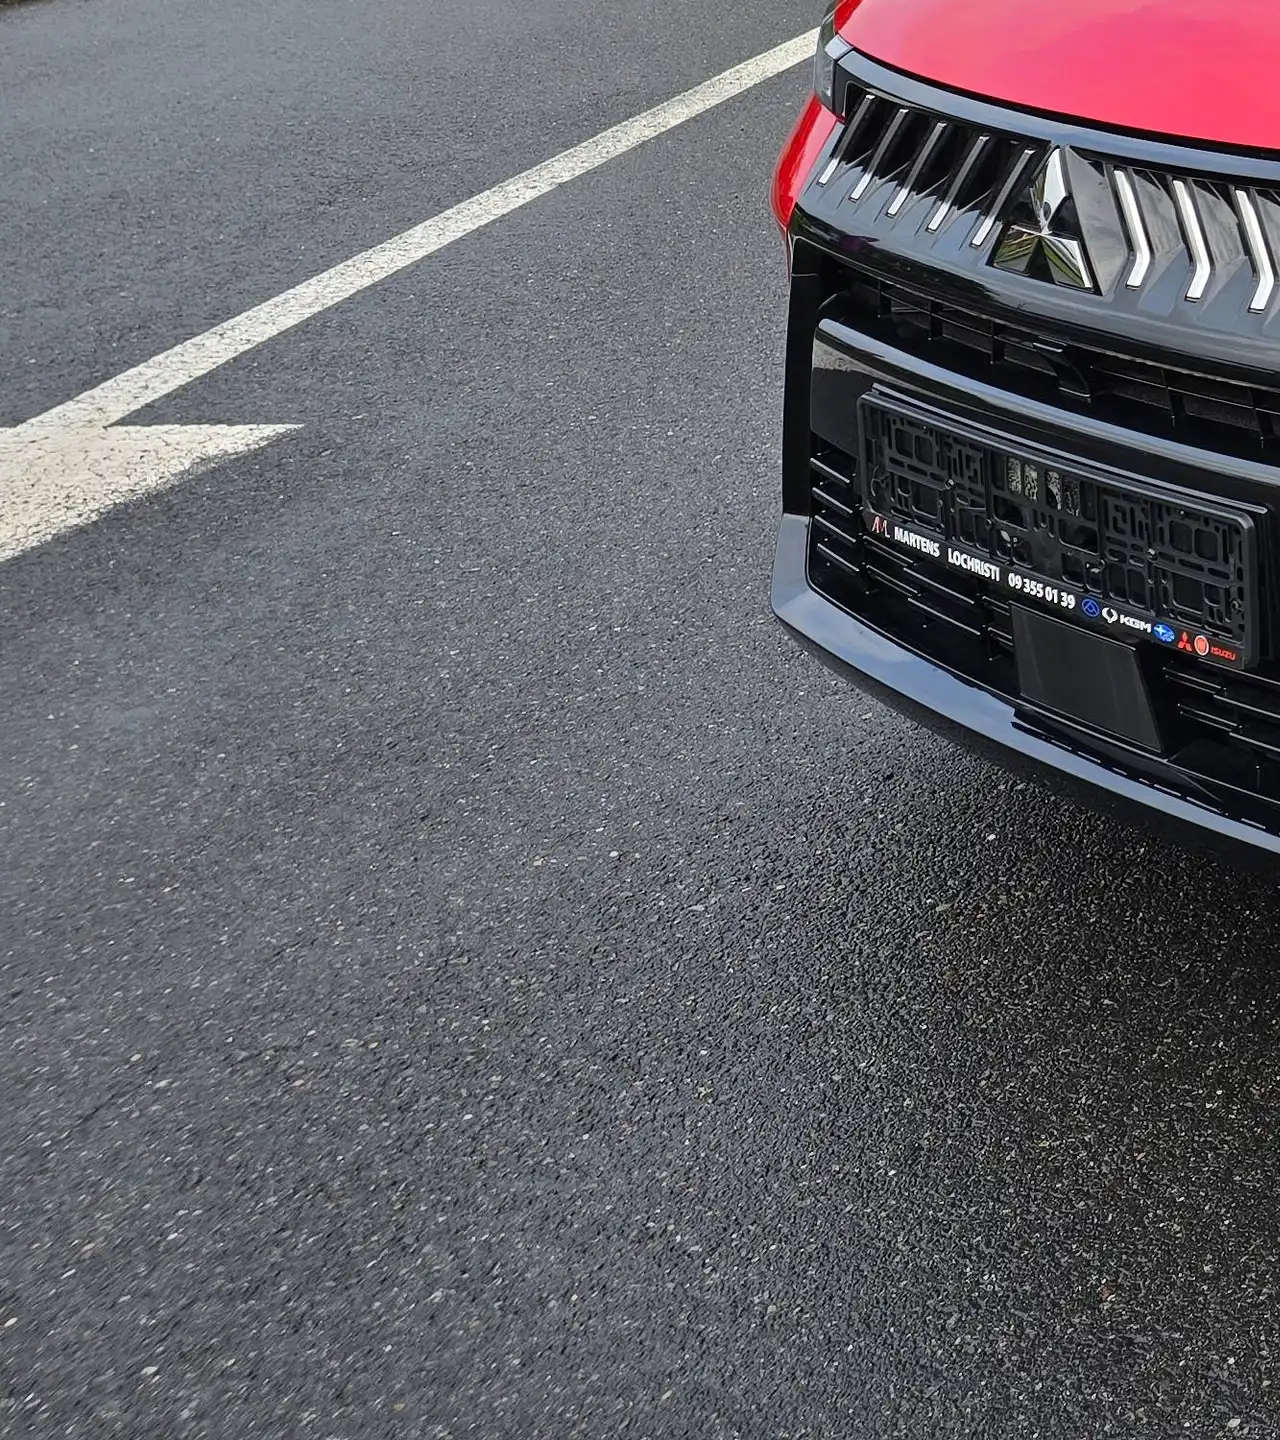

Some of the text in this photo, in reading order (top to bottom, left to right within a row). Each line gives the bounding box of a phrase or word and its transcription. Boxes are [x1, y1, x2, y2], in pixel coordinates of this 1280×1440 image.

[894, 526, 941, 558] MARTENS
[947, 547, 1000, 582] LOCHRISTI
[1007, 572, 1023, 590] 09
[1022, 578, 1044, 598] 355
[1044, 586, 1059, 604] 01
[1060, 592, 1076, 610] 39
[1119, 613, 1152, 634] KGM
[1210, 646, 1236, 661] ISUZU
